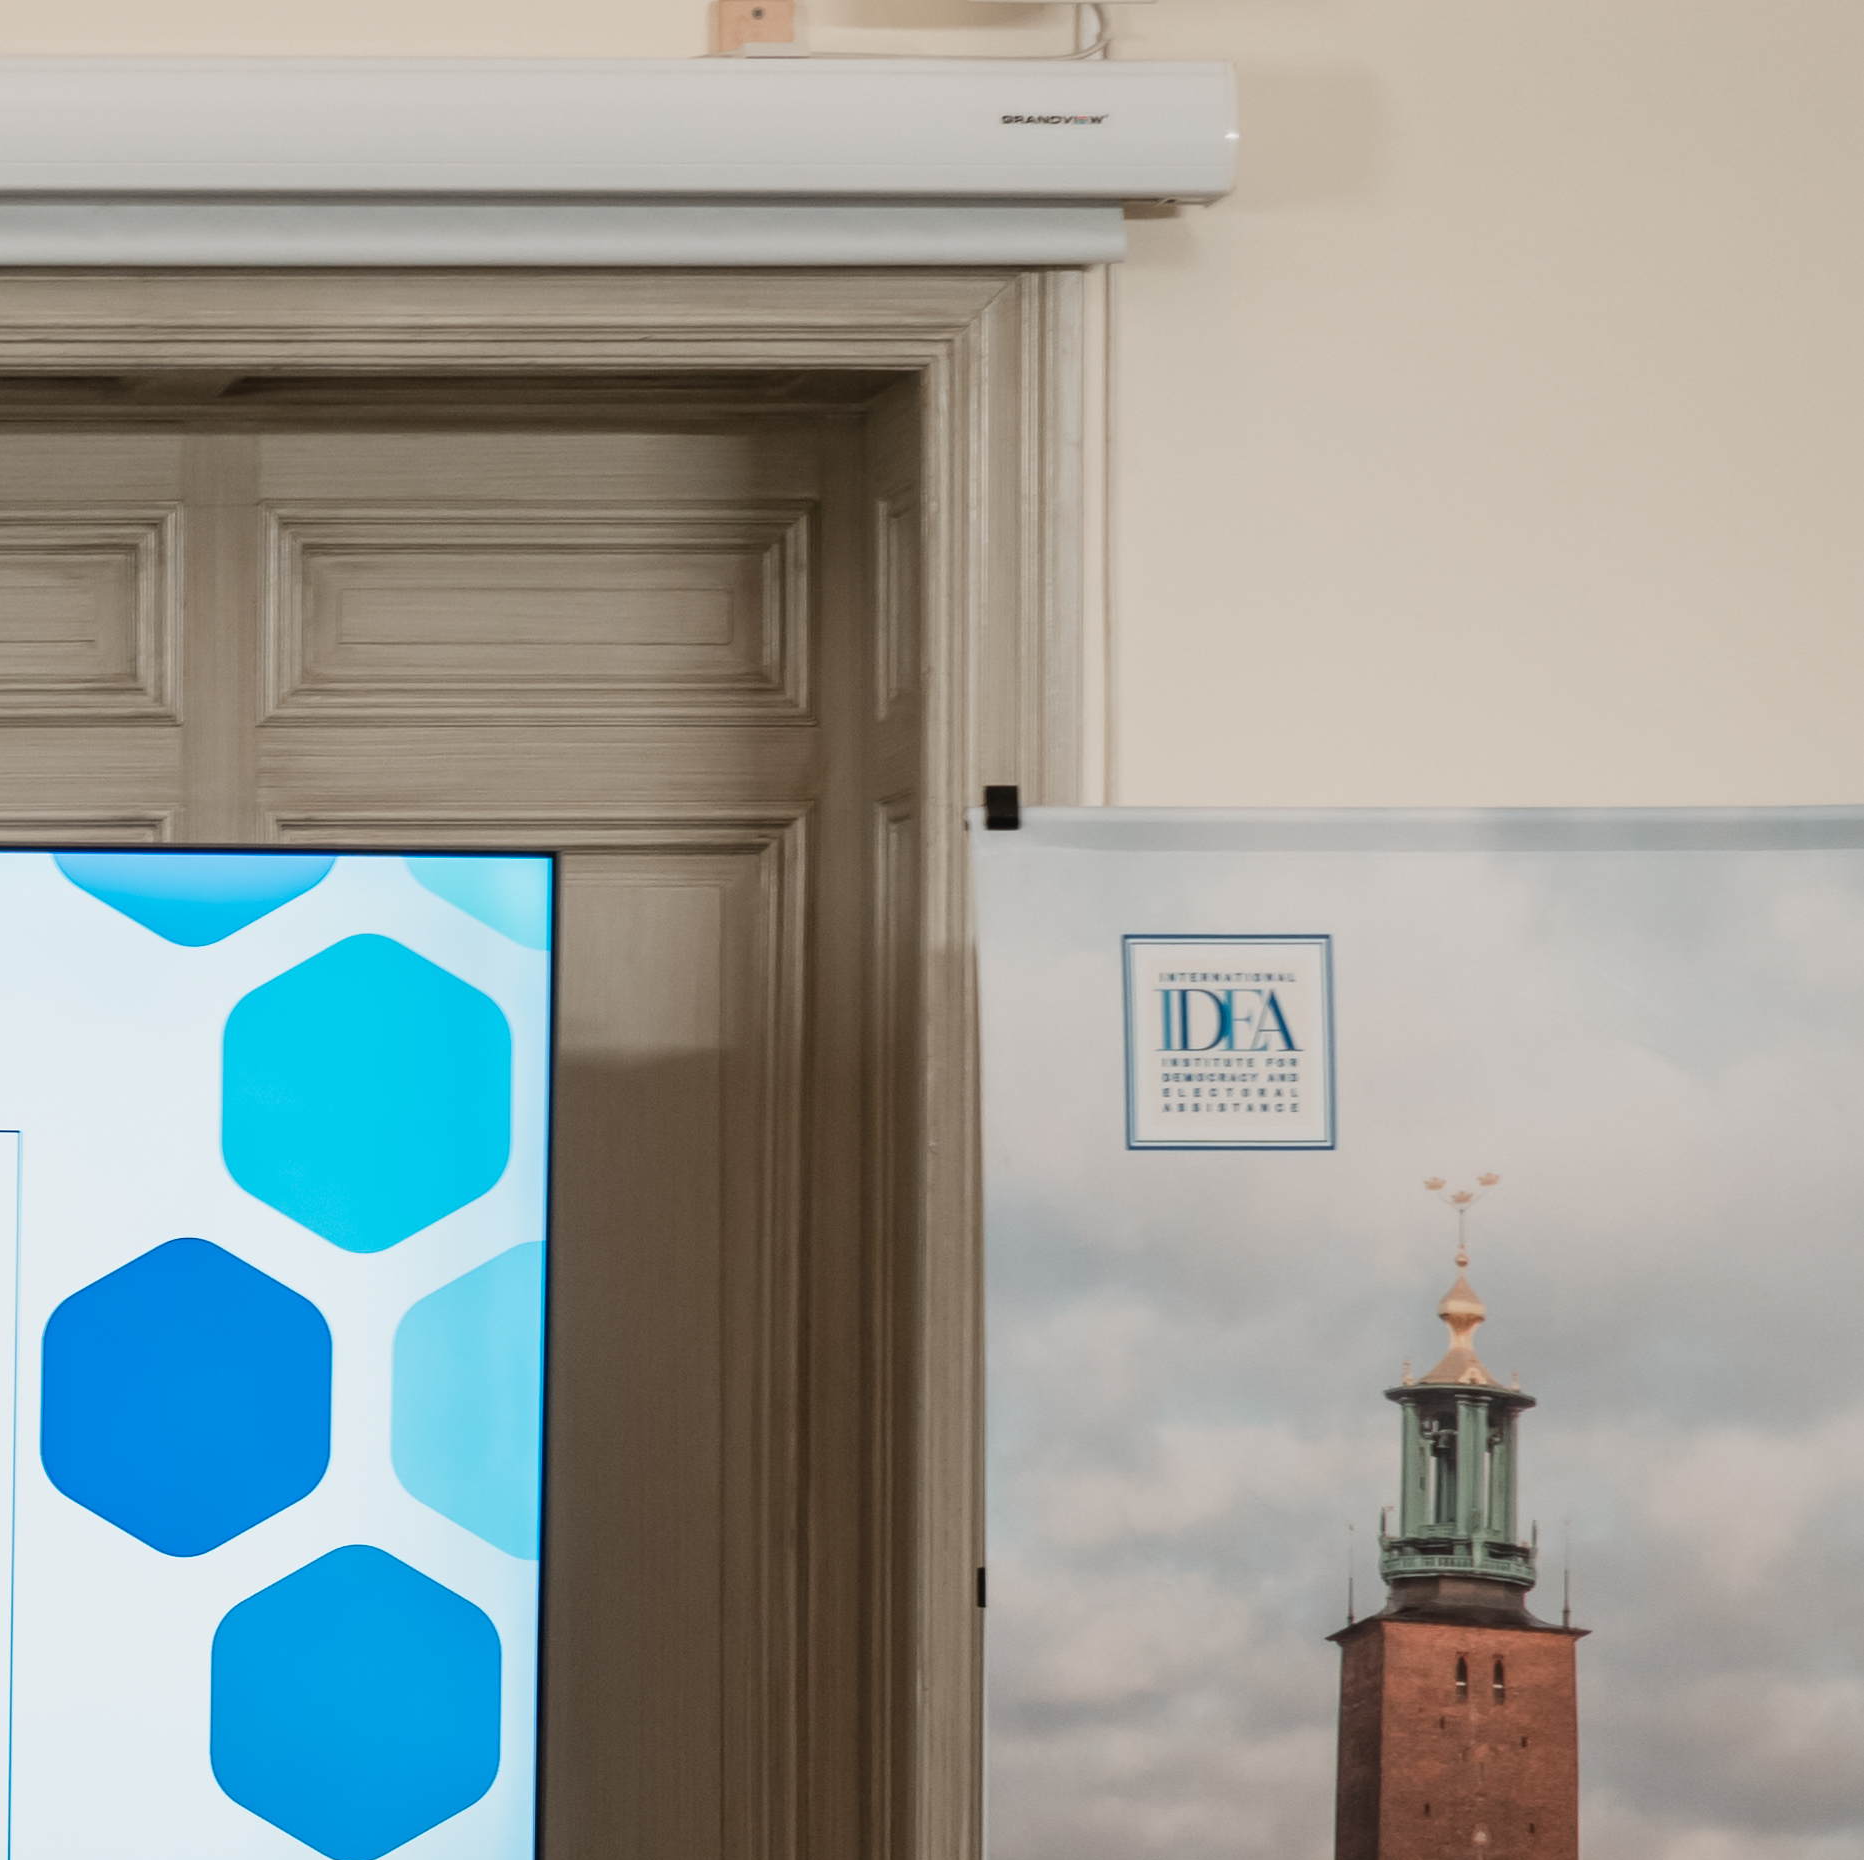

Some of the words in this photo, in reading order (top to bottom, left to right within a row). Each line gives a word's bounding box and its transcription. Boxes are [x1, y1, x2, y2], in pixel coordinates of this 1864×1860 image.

[1159, 972, 1297, 983] INTERNATIONAL
[1153, 987, 1305, 1052] IDEA
[1161, 1057, 1256, 1068] INSTITUTE
[1265, 1057, 1299, 1068] FOR
[1161, 1072, 1258, 1083] DEMOCRACY
[1267, 1072, 1299, 1083] AND
[1161, 1087, 1299, 1098] ELECTORAL
[1162, 1102, 1300, 1113] ASSISTANCE
